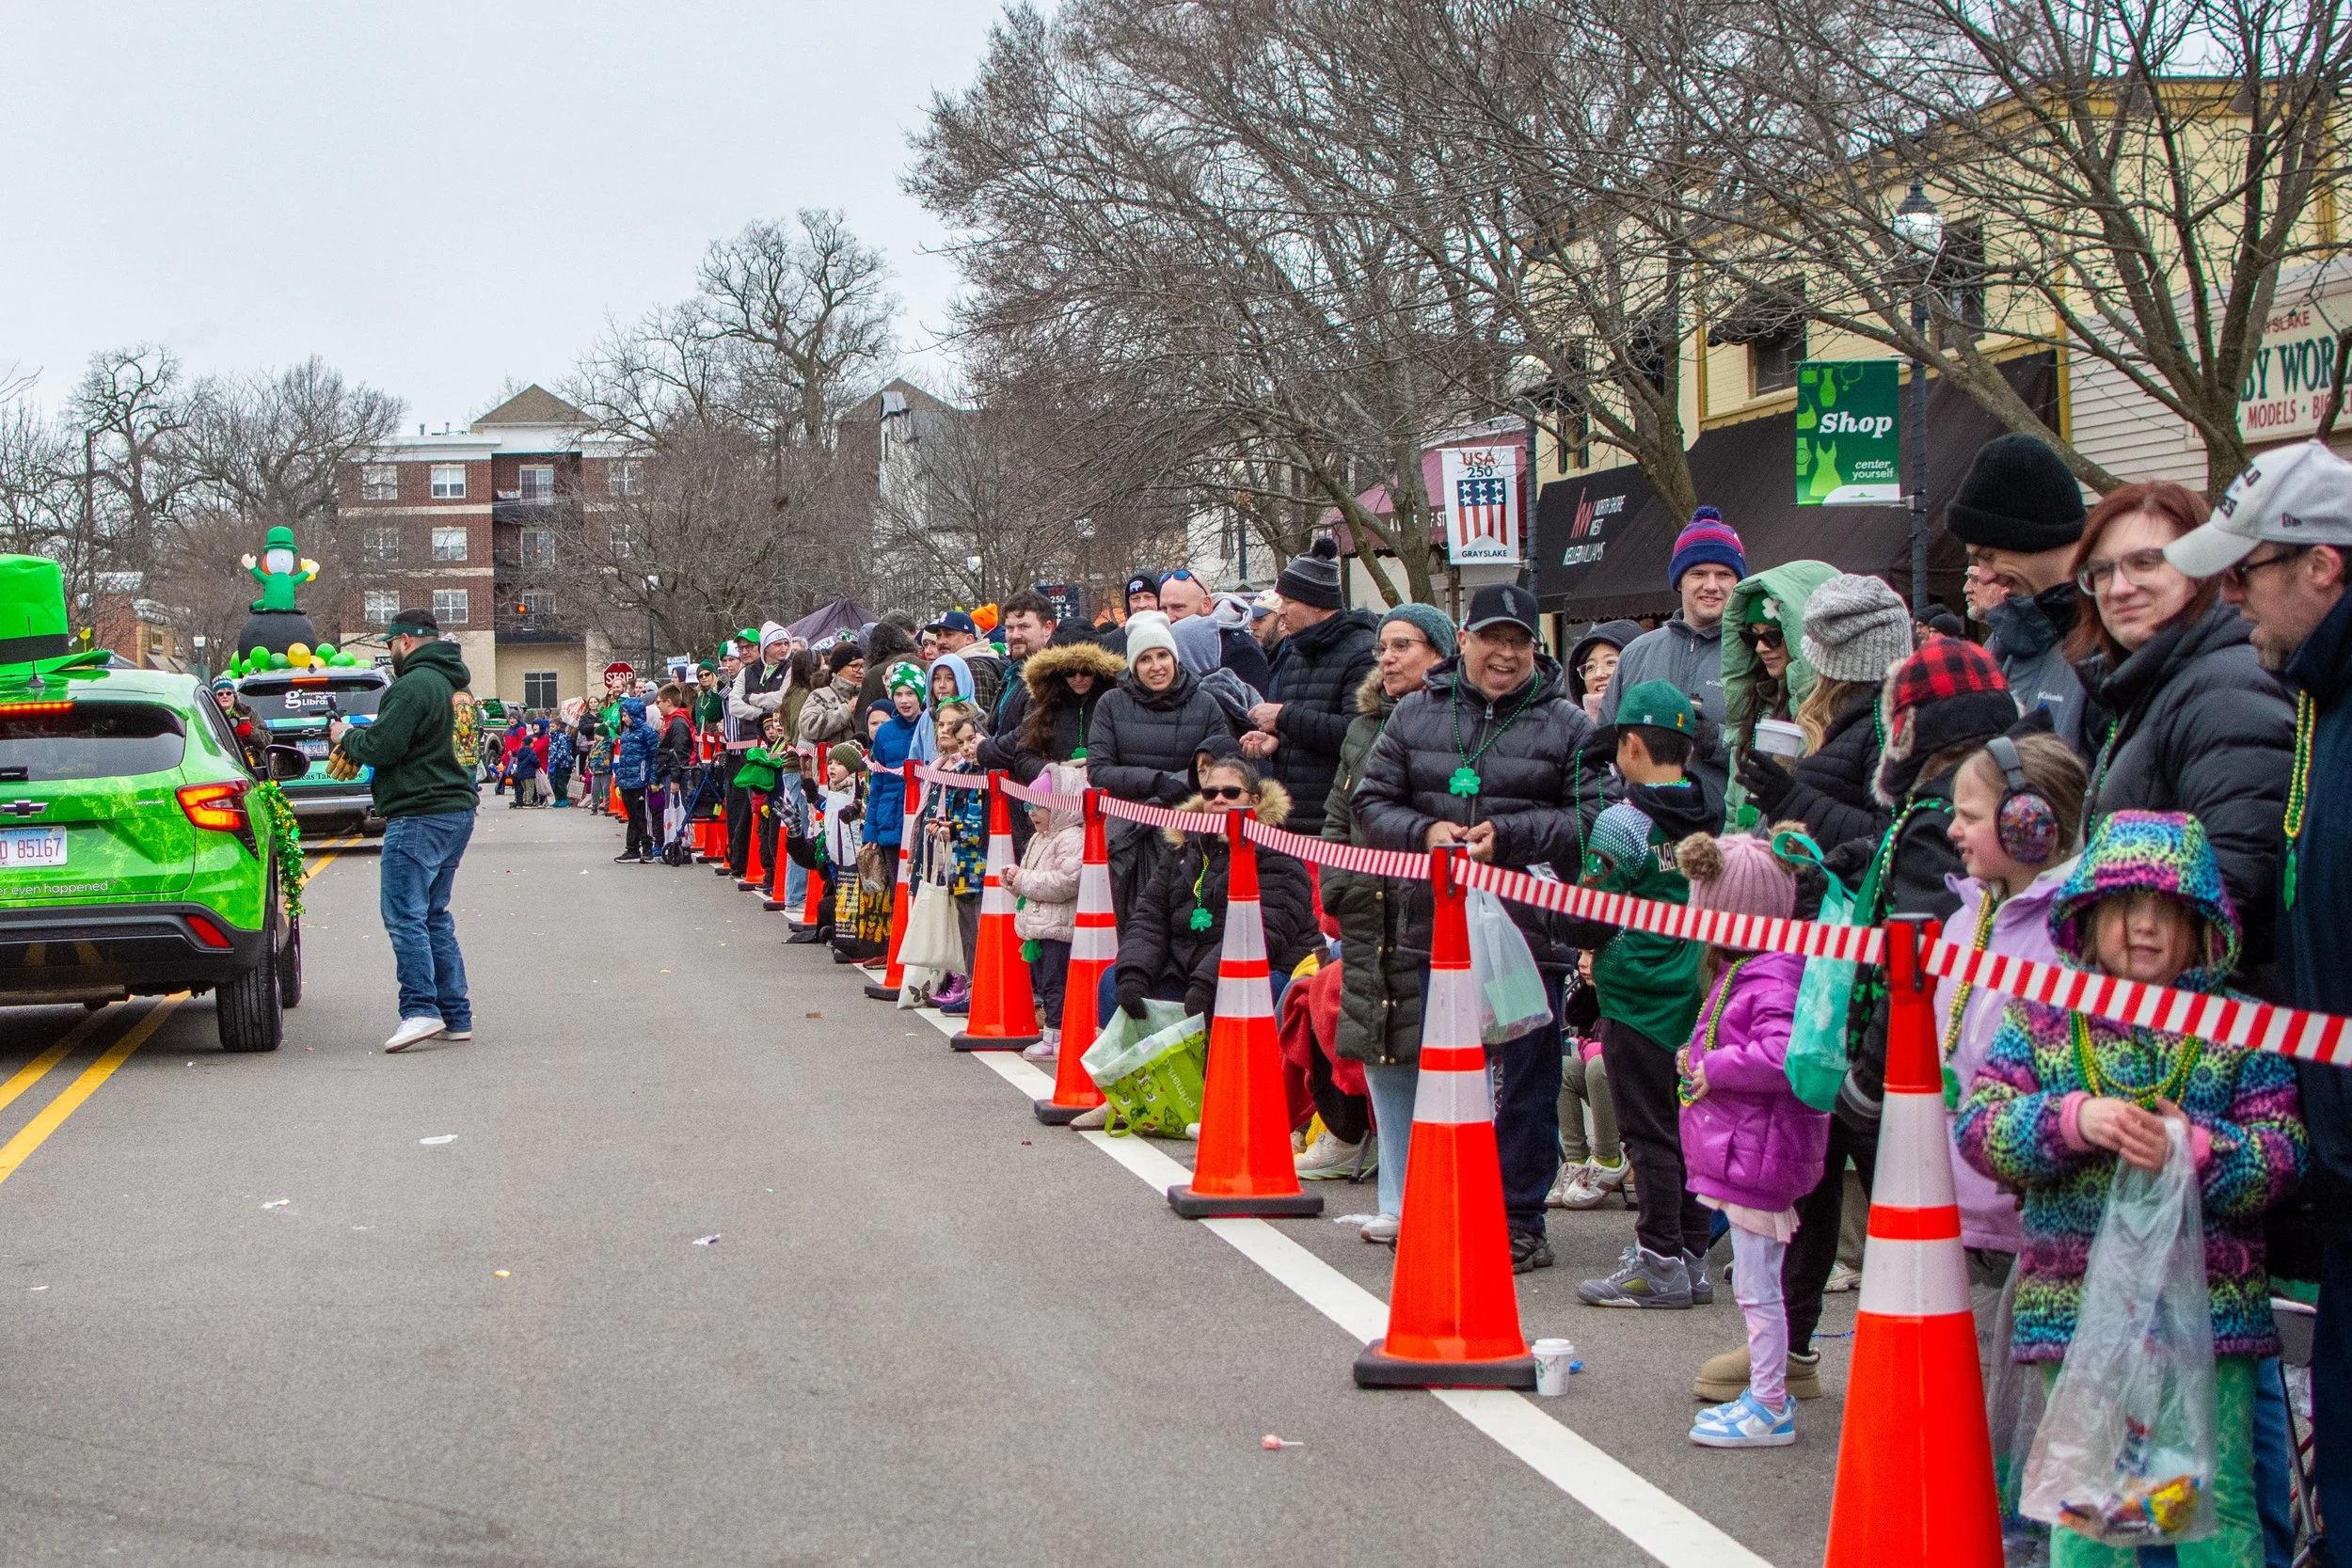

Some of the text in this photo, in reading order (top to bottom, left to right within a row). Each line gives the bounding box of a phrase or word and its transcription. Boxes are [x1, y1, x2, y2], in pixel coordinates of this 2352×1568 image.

[2247, 400, 2296, 430] MODELS
[1819, 411, 1893, 438] Shop
[1462, 452, 1496, 467] USA
[1854, 459, 1891, 469] center
[1467, 467, 1493, 479] 250
[1852, 467, 1894, 481] yourself
[1461, 549, 1508, 558] GRAYSLAKE
[605, 672, 634, 686] STOP
[1677, 713, 1684, 728] 1
[18, 838, 61, 859] 85167
[11, 886, 41, 895] even
